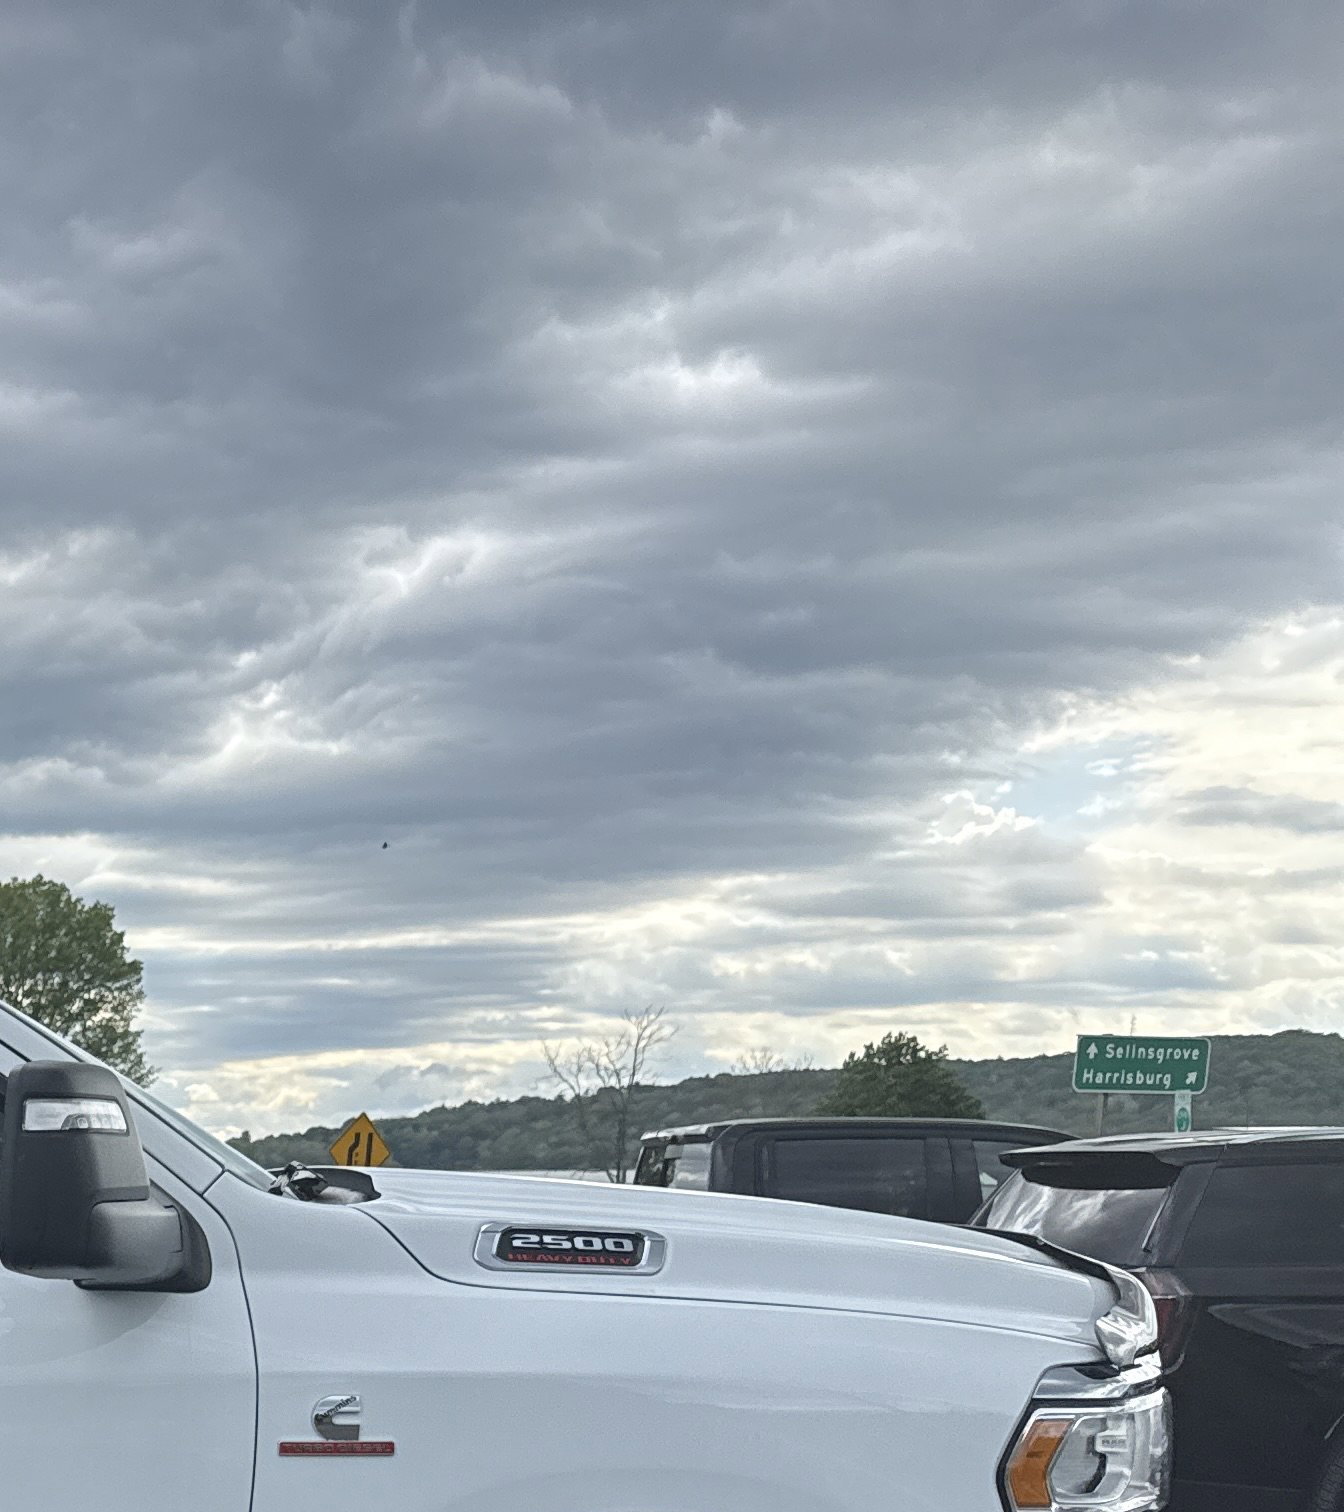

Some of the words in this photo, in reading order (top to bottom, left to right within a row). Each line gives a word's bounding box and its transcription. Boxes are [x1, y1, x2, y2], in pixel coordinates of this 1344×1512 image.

[1105, 1043, 1200, 1064] Selinsgrove
[1082, 1068, 1172, 1089] Harrisburg
[511, 1233, 634, 1252] 2500
